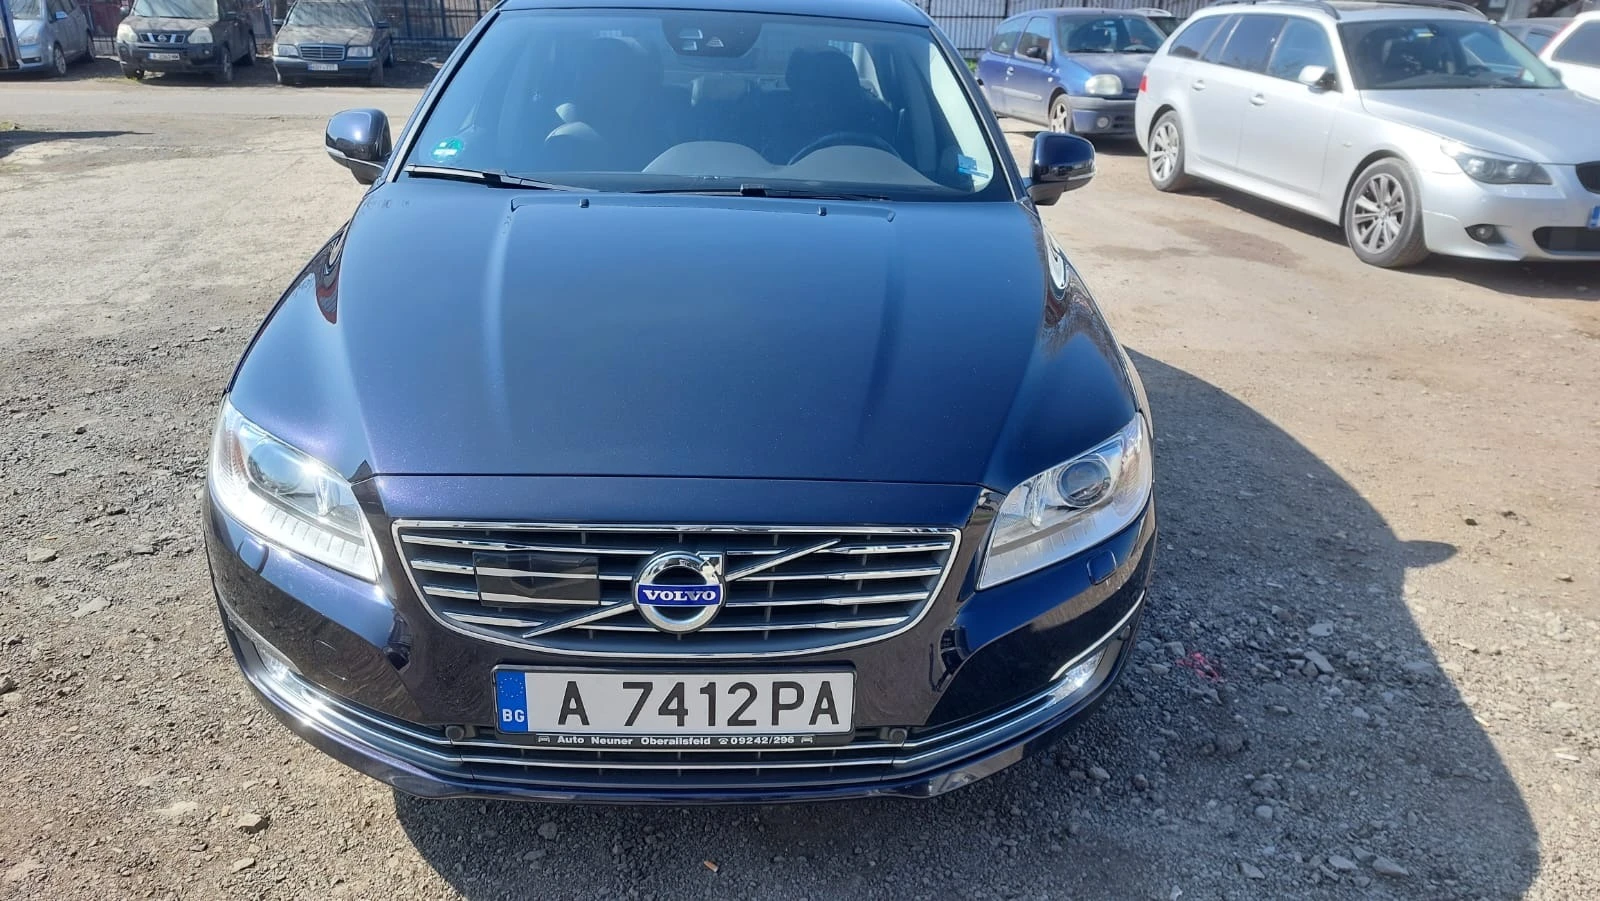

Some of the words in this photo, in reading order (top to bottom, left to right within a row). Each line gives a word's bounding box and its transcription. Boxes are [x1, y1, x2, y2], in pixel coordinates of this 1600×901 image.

[643, 589, 717, 601] VOLVO
[557, 680, 590, 726] A
[502, 709, 525, 722] BG
[557, 735, 585, 744] Auto
[591, 736, 633, 745] Neuner
[730, 736, 795, 744] 09242/296
